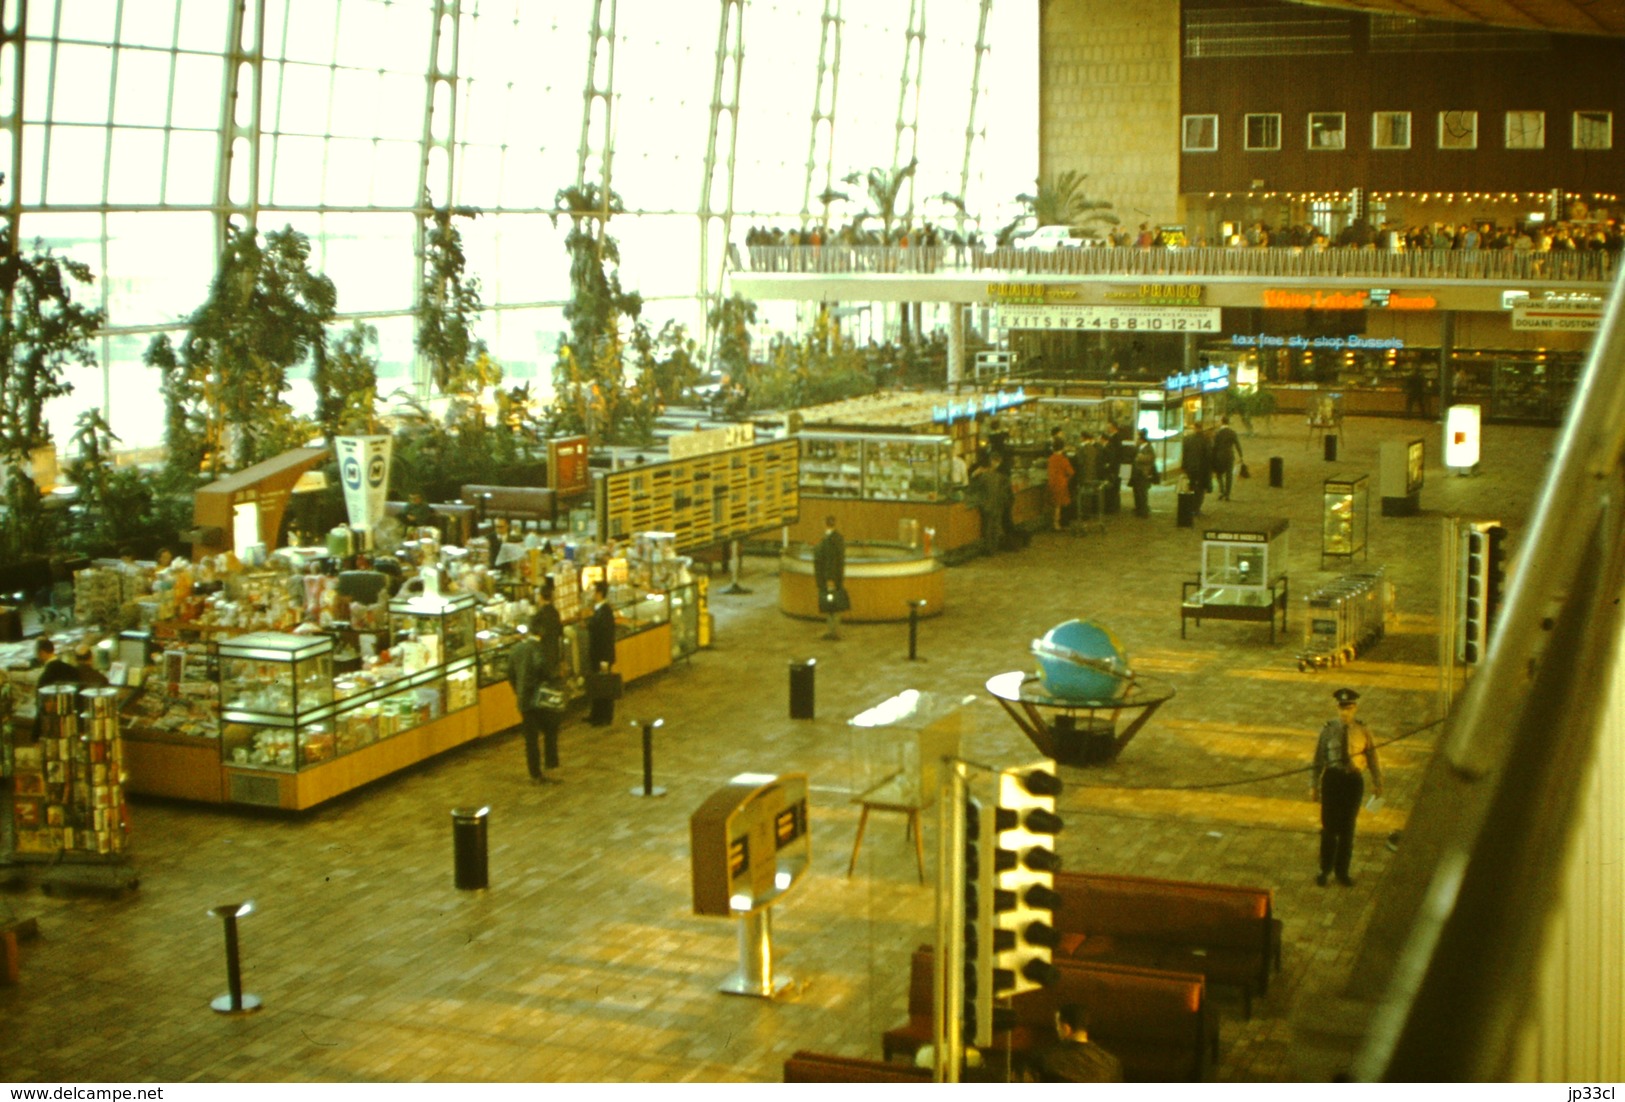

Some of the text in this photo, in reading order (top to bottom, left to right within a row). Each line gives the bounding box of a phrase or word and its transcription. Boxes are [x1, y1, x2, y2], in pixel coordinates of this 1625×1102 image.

[986, 283, 1045, 297] PRADO
[1139, 283, 1201, 298] PRADO
[1000, 316, 1052, 328] EXITS
[1231, 333, 1404, 350] tax free sky shop Brussels
